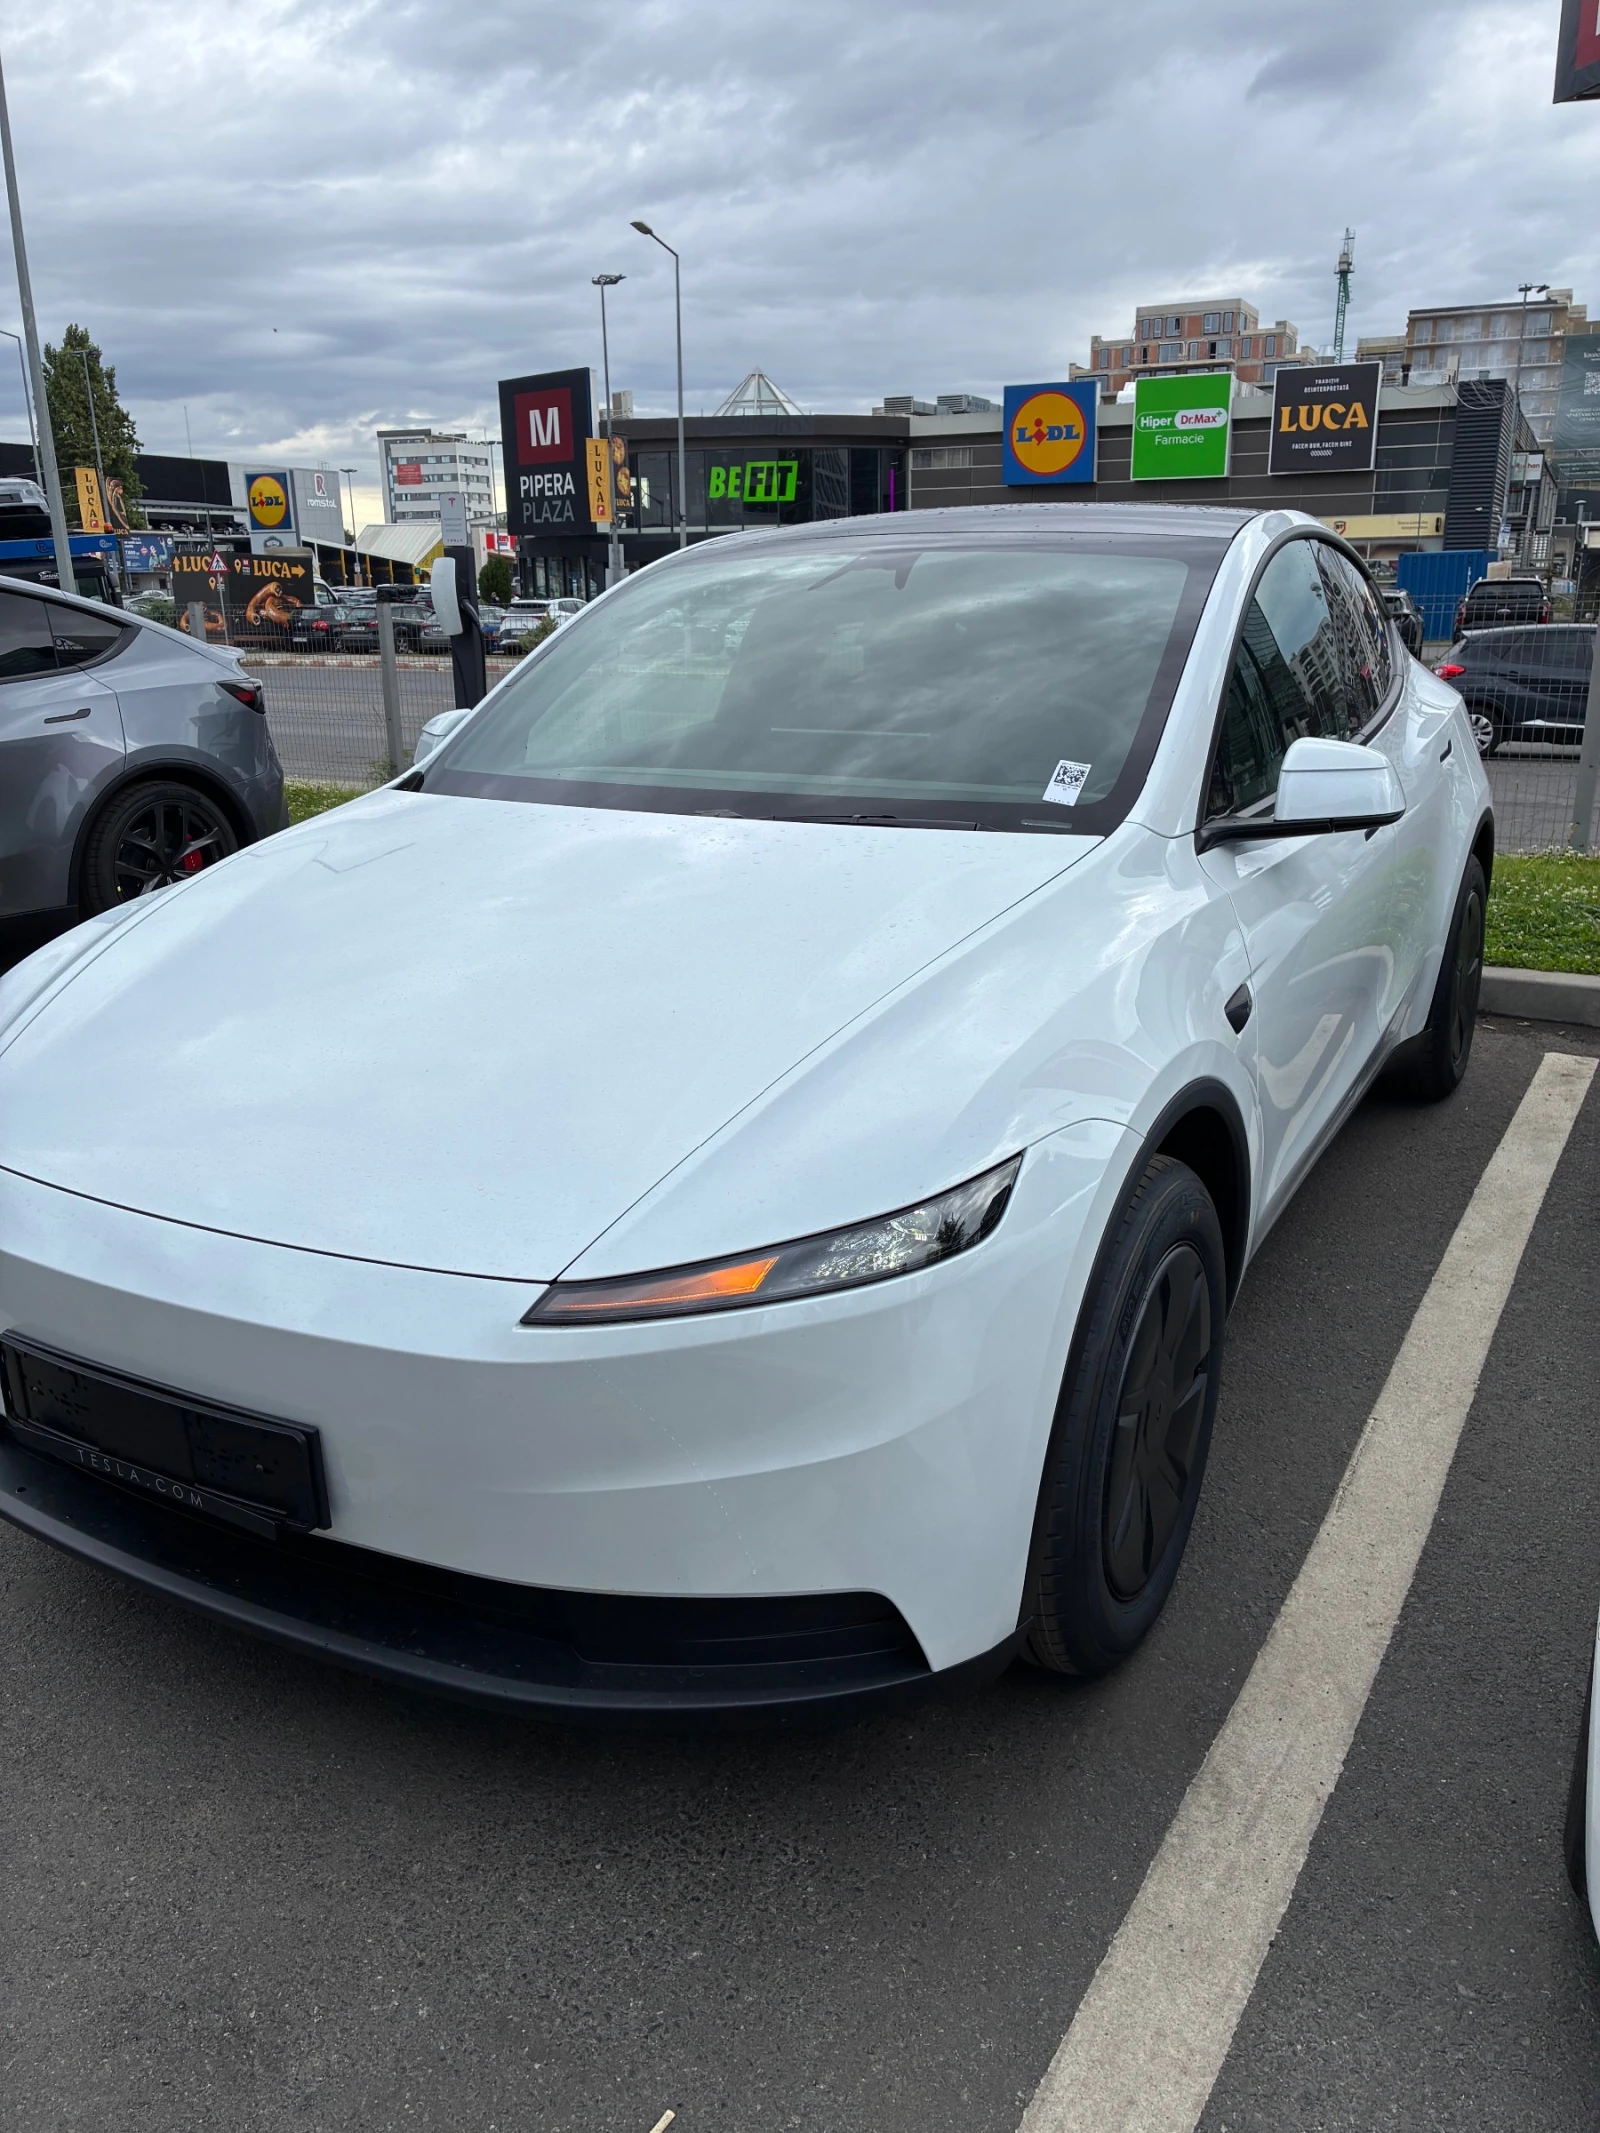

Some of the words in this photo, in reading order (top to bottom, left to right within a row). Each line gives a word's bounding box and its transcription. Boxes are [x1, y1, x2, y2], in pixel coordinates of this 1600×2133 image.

[529, 406, 560, 447] M
[1140, 415, 1172, 429] Hiper
[1279, 402, 1368, 432] LUCA
[1016, 417, 1080, 446] LIDL
[1155, 432, 1204, 446] Farmacie
[520, 472, 575, 498] PIPERA
[594, 445, 604, 503] LUCA
[84, 473, 97, 518] LUCA
[251, 492, 283, 509] LIDL
[616, 498, 630, 507] LUCA
[523, 500, 574, 524] PLAZA
[182, 556, 212, 572] LUC
[253, 559, 292, 579] LUCA
[78, 1449, 203, 1508] TESLA.COM
